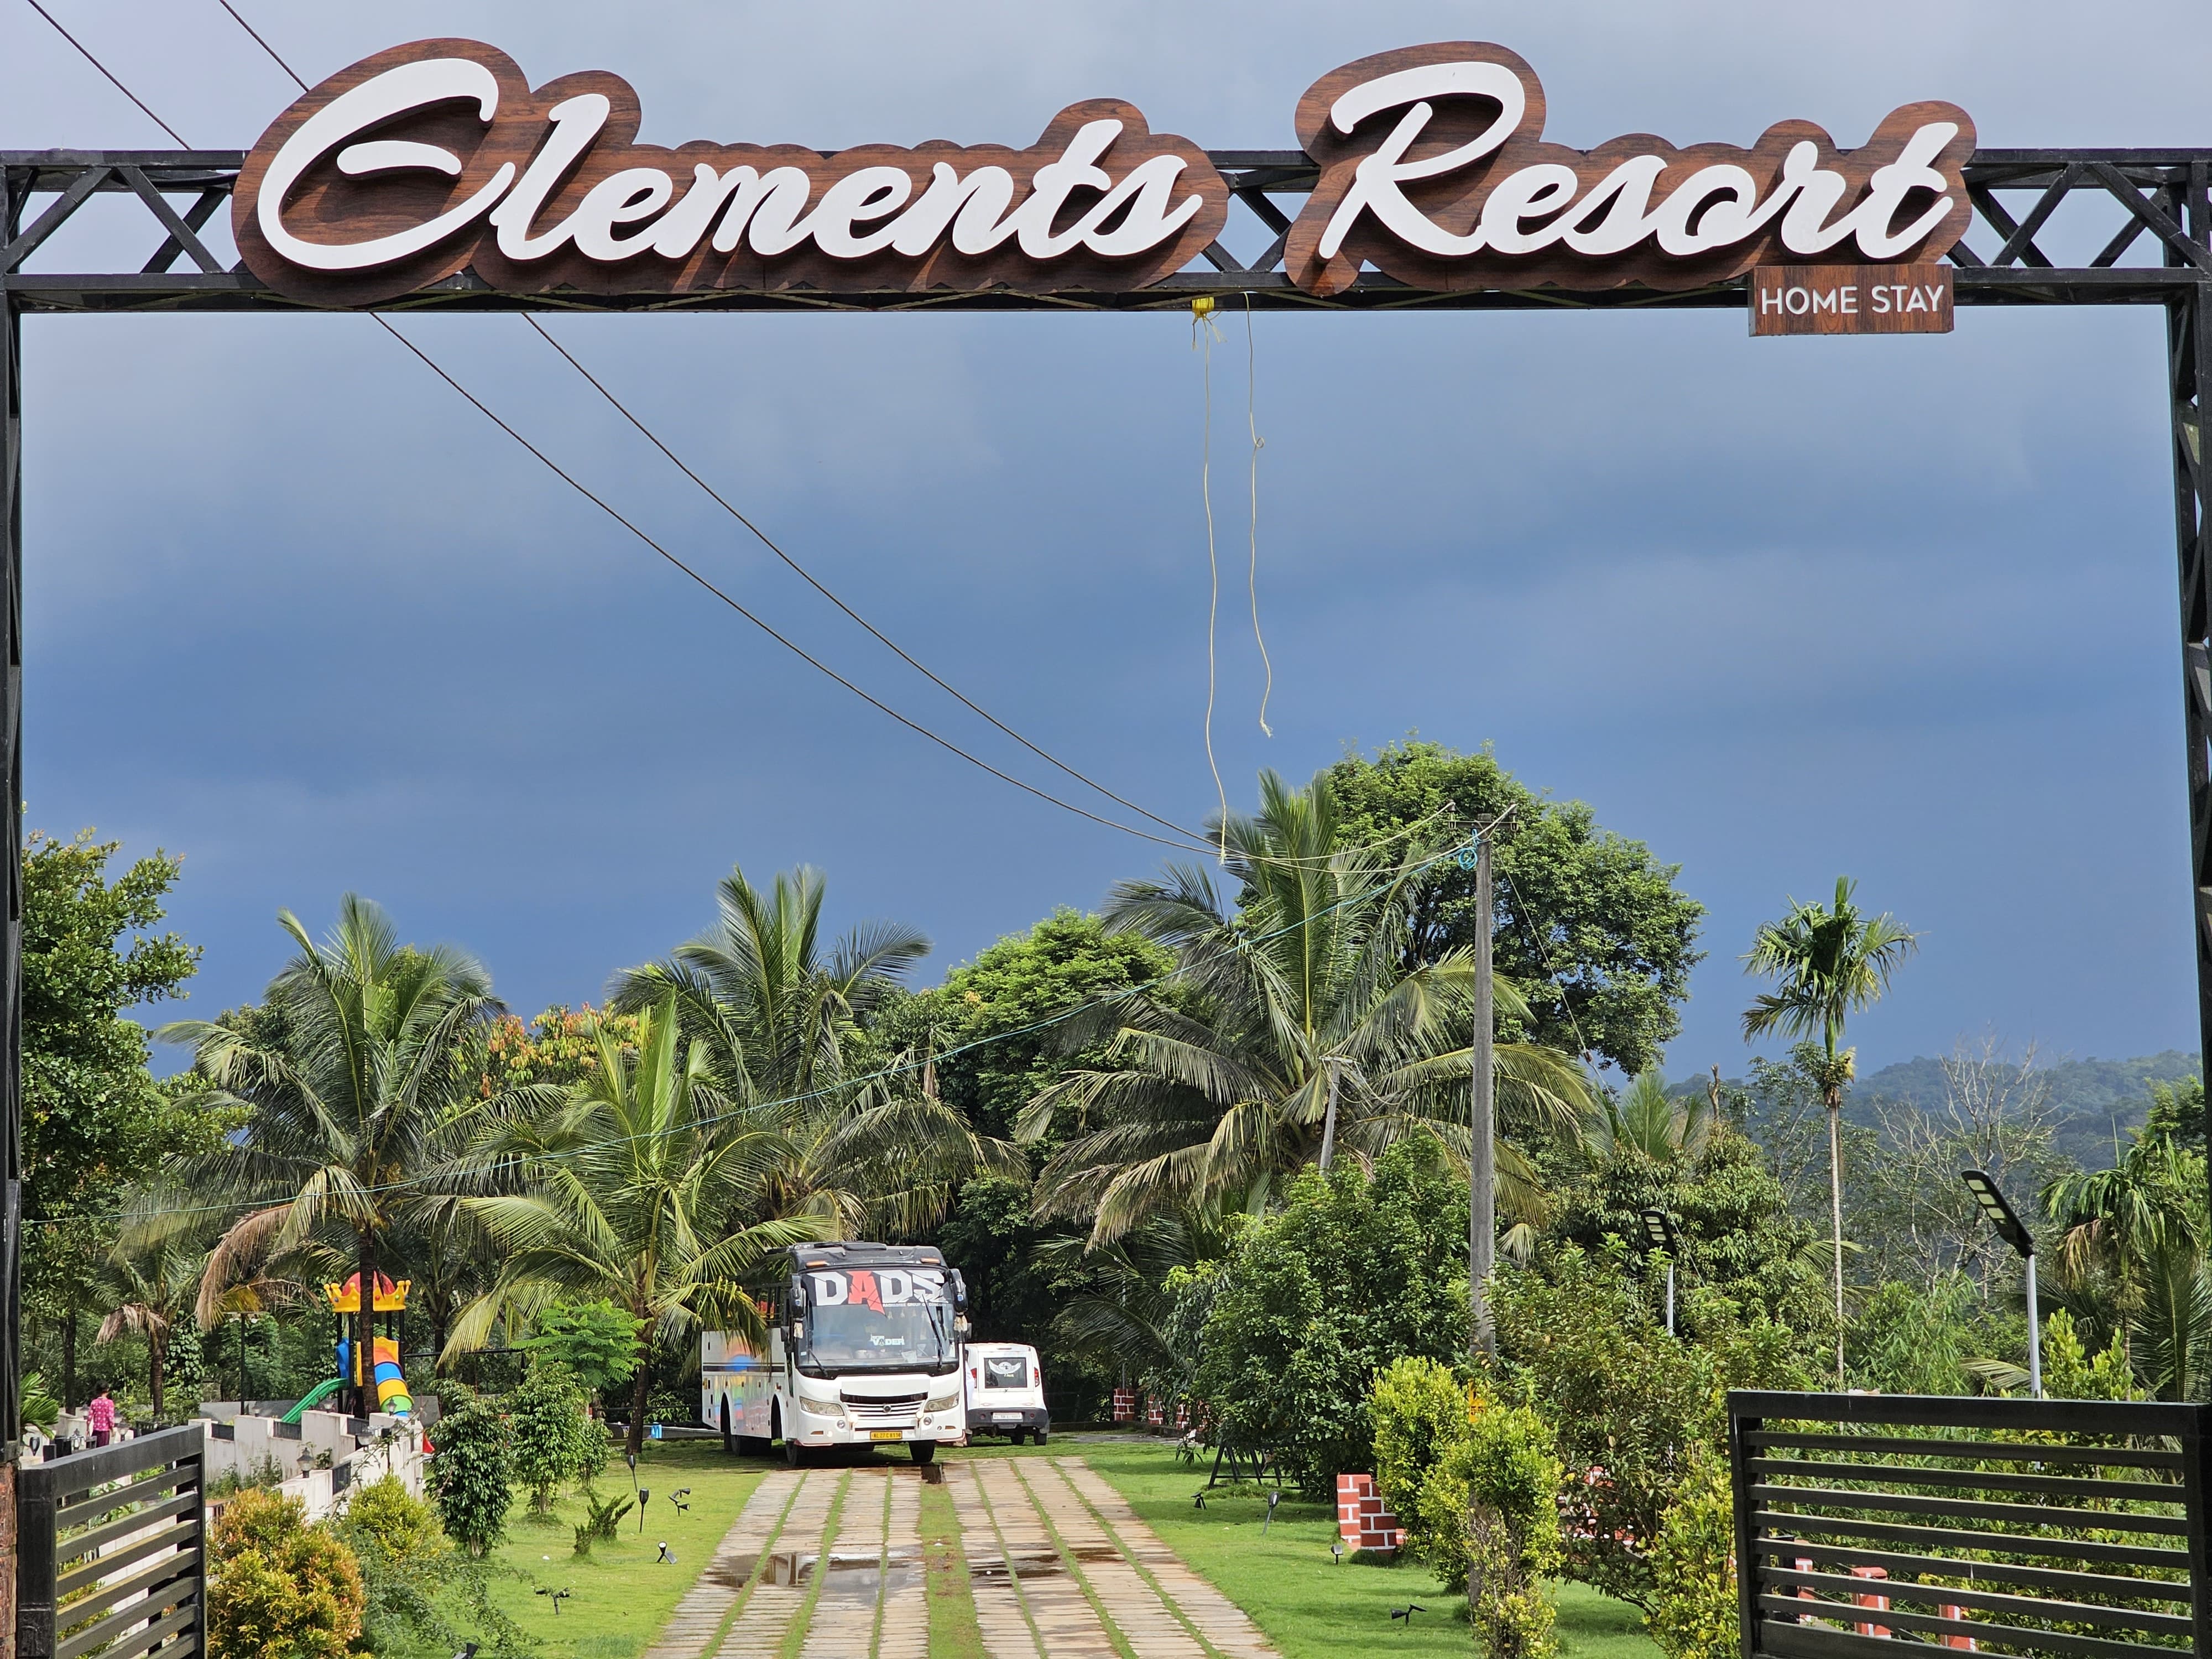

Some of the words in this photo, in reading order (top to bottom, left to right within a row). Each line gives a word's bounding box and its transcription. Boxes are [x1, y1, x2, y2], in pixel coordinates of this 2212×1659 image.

[257, 58, 1203, 269] Elements
[1318, 61, 1960, 260] Resort
[1761, 286, 1859, 315] HOME
[1871, 284, 1944, 314] STAY
[806, 1270, 948, 1315] DADS
